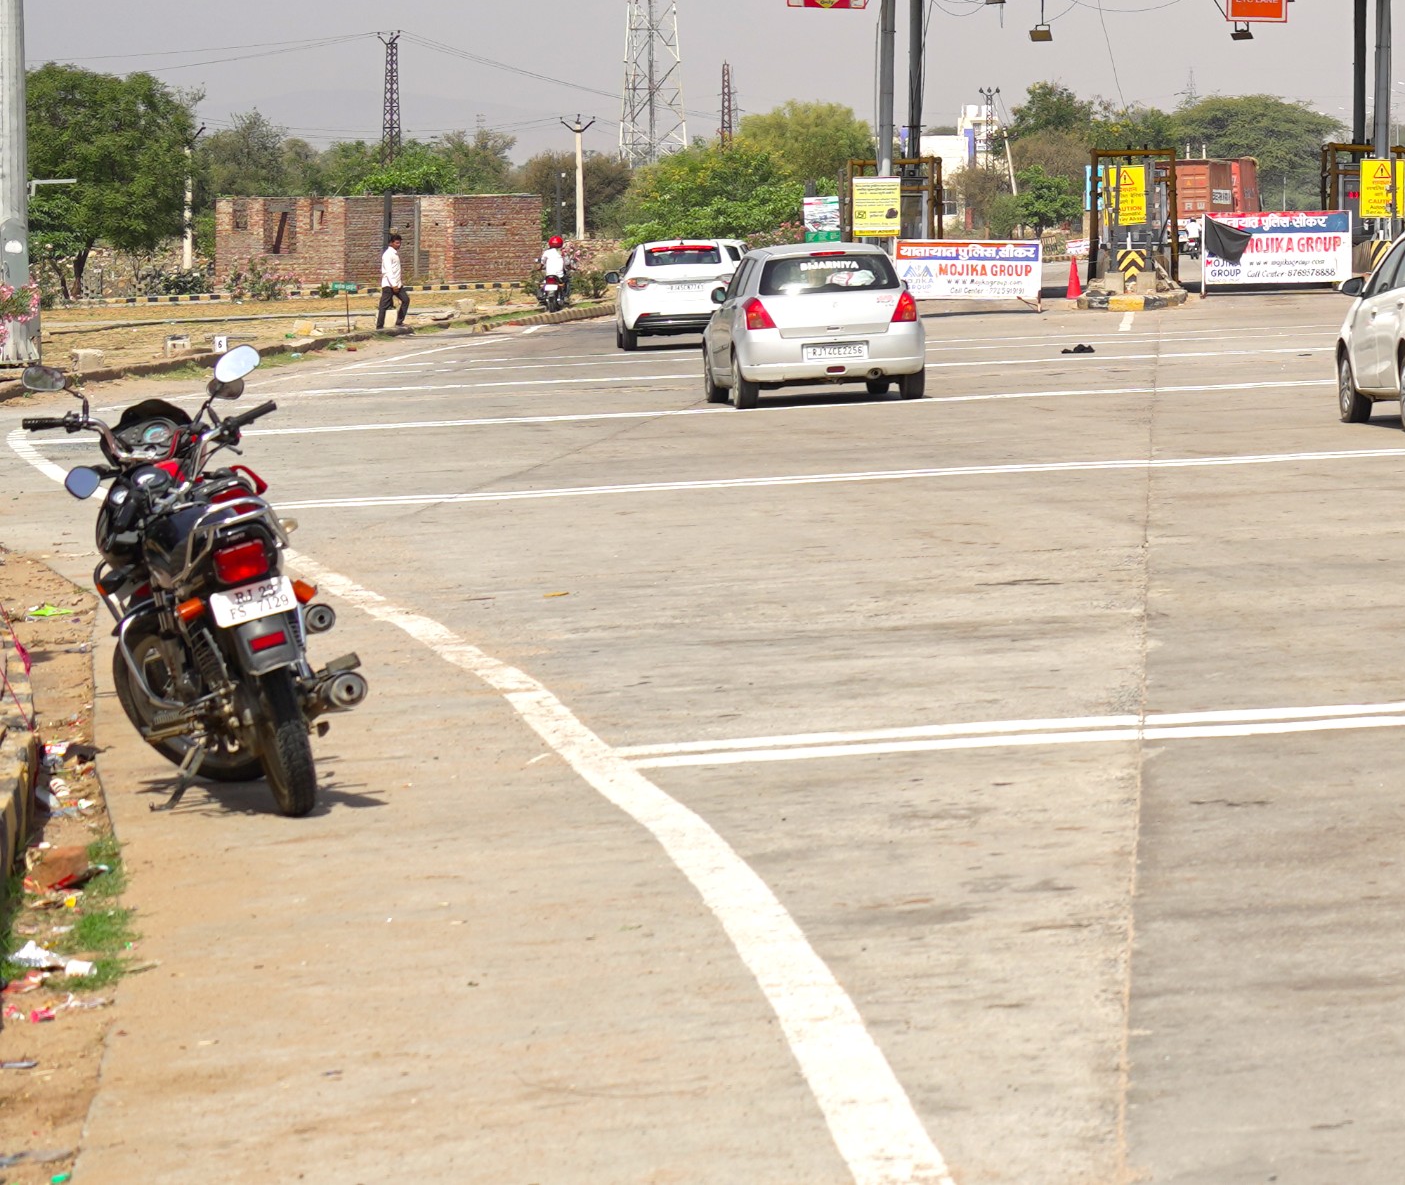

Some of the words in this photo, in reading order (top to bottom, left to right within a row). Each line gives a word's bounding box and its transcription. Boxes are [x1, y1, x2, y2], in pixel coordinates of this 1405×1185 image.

[1245, 237, 1294, 253] MOJIKA
[1298, 236, 1341, 252] GROUP
[938, 264, 987, 276] MOJIKA
[991, 264, 1032, 276] GROUP
[1211, 269, 1241, 277] GROUP
